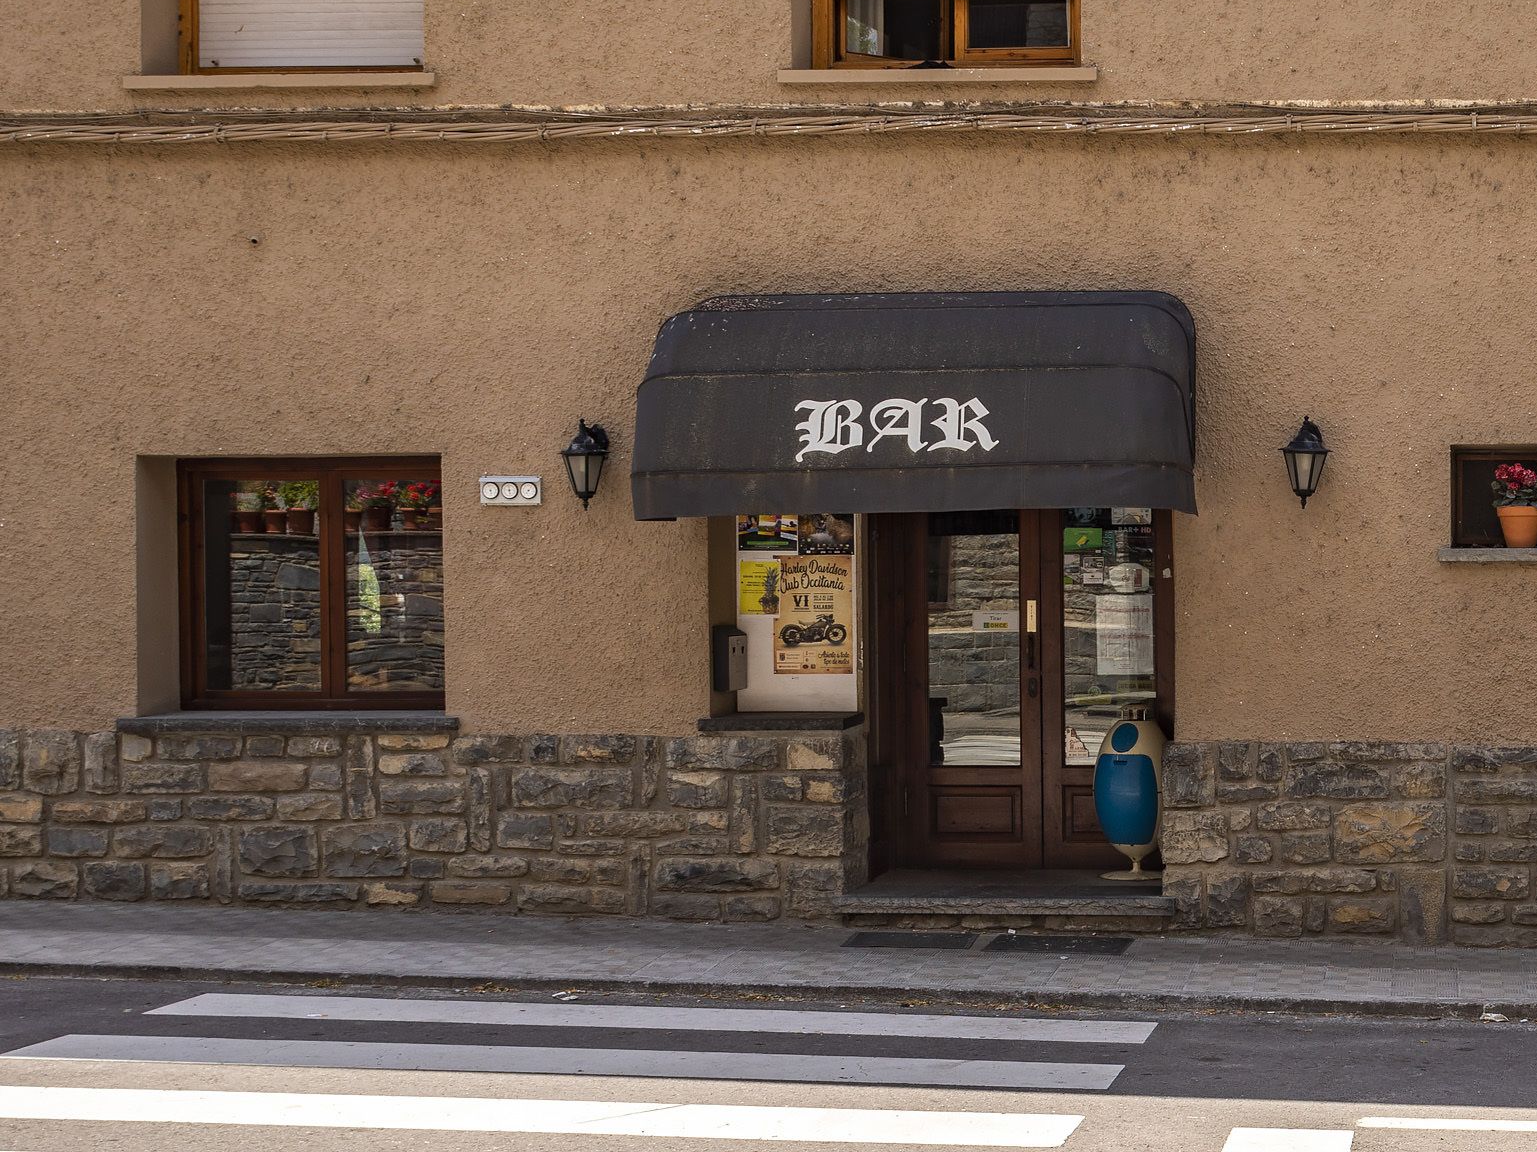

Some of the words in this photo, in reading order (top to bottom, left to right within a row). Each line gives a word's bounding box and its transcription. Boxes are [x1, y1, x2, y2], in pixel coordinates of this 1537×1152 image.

[793, 396, 1000, 463] BAR
[1140, 526, 1152, 534] HD
[780, 562, 808, 576] Harley
[808, 559, 849, 577] Davidson
[780, 576, 800, 594] Club
[800, 573, 845, 591] Occitania
[792, 594, 810, 608] VI
